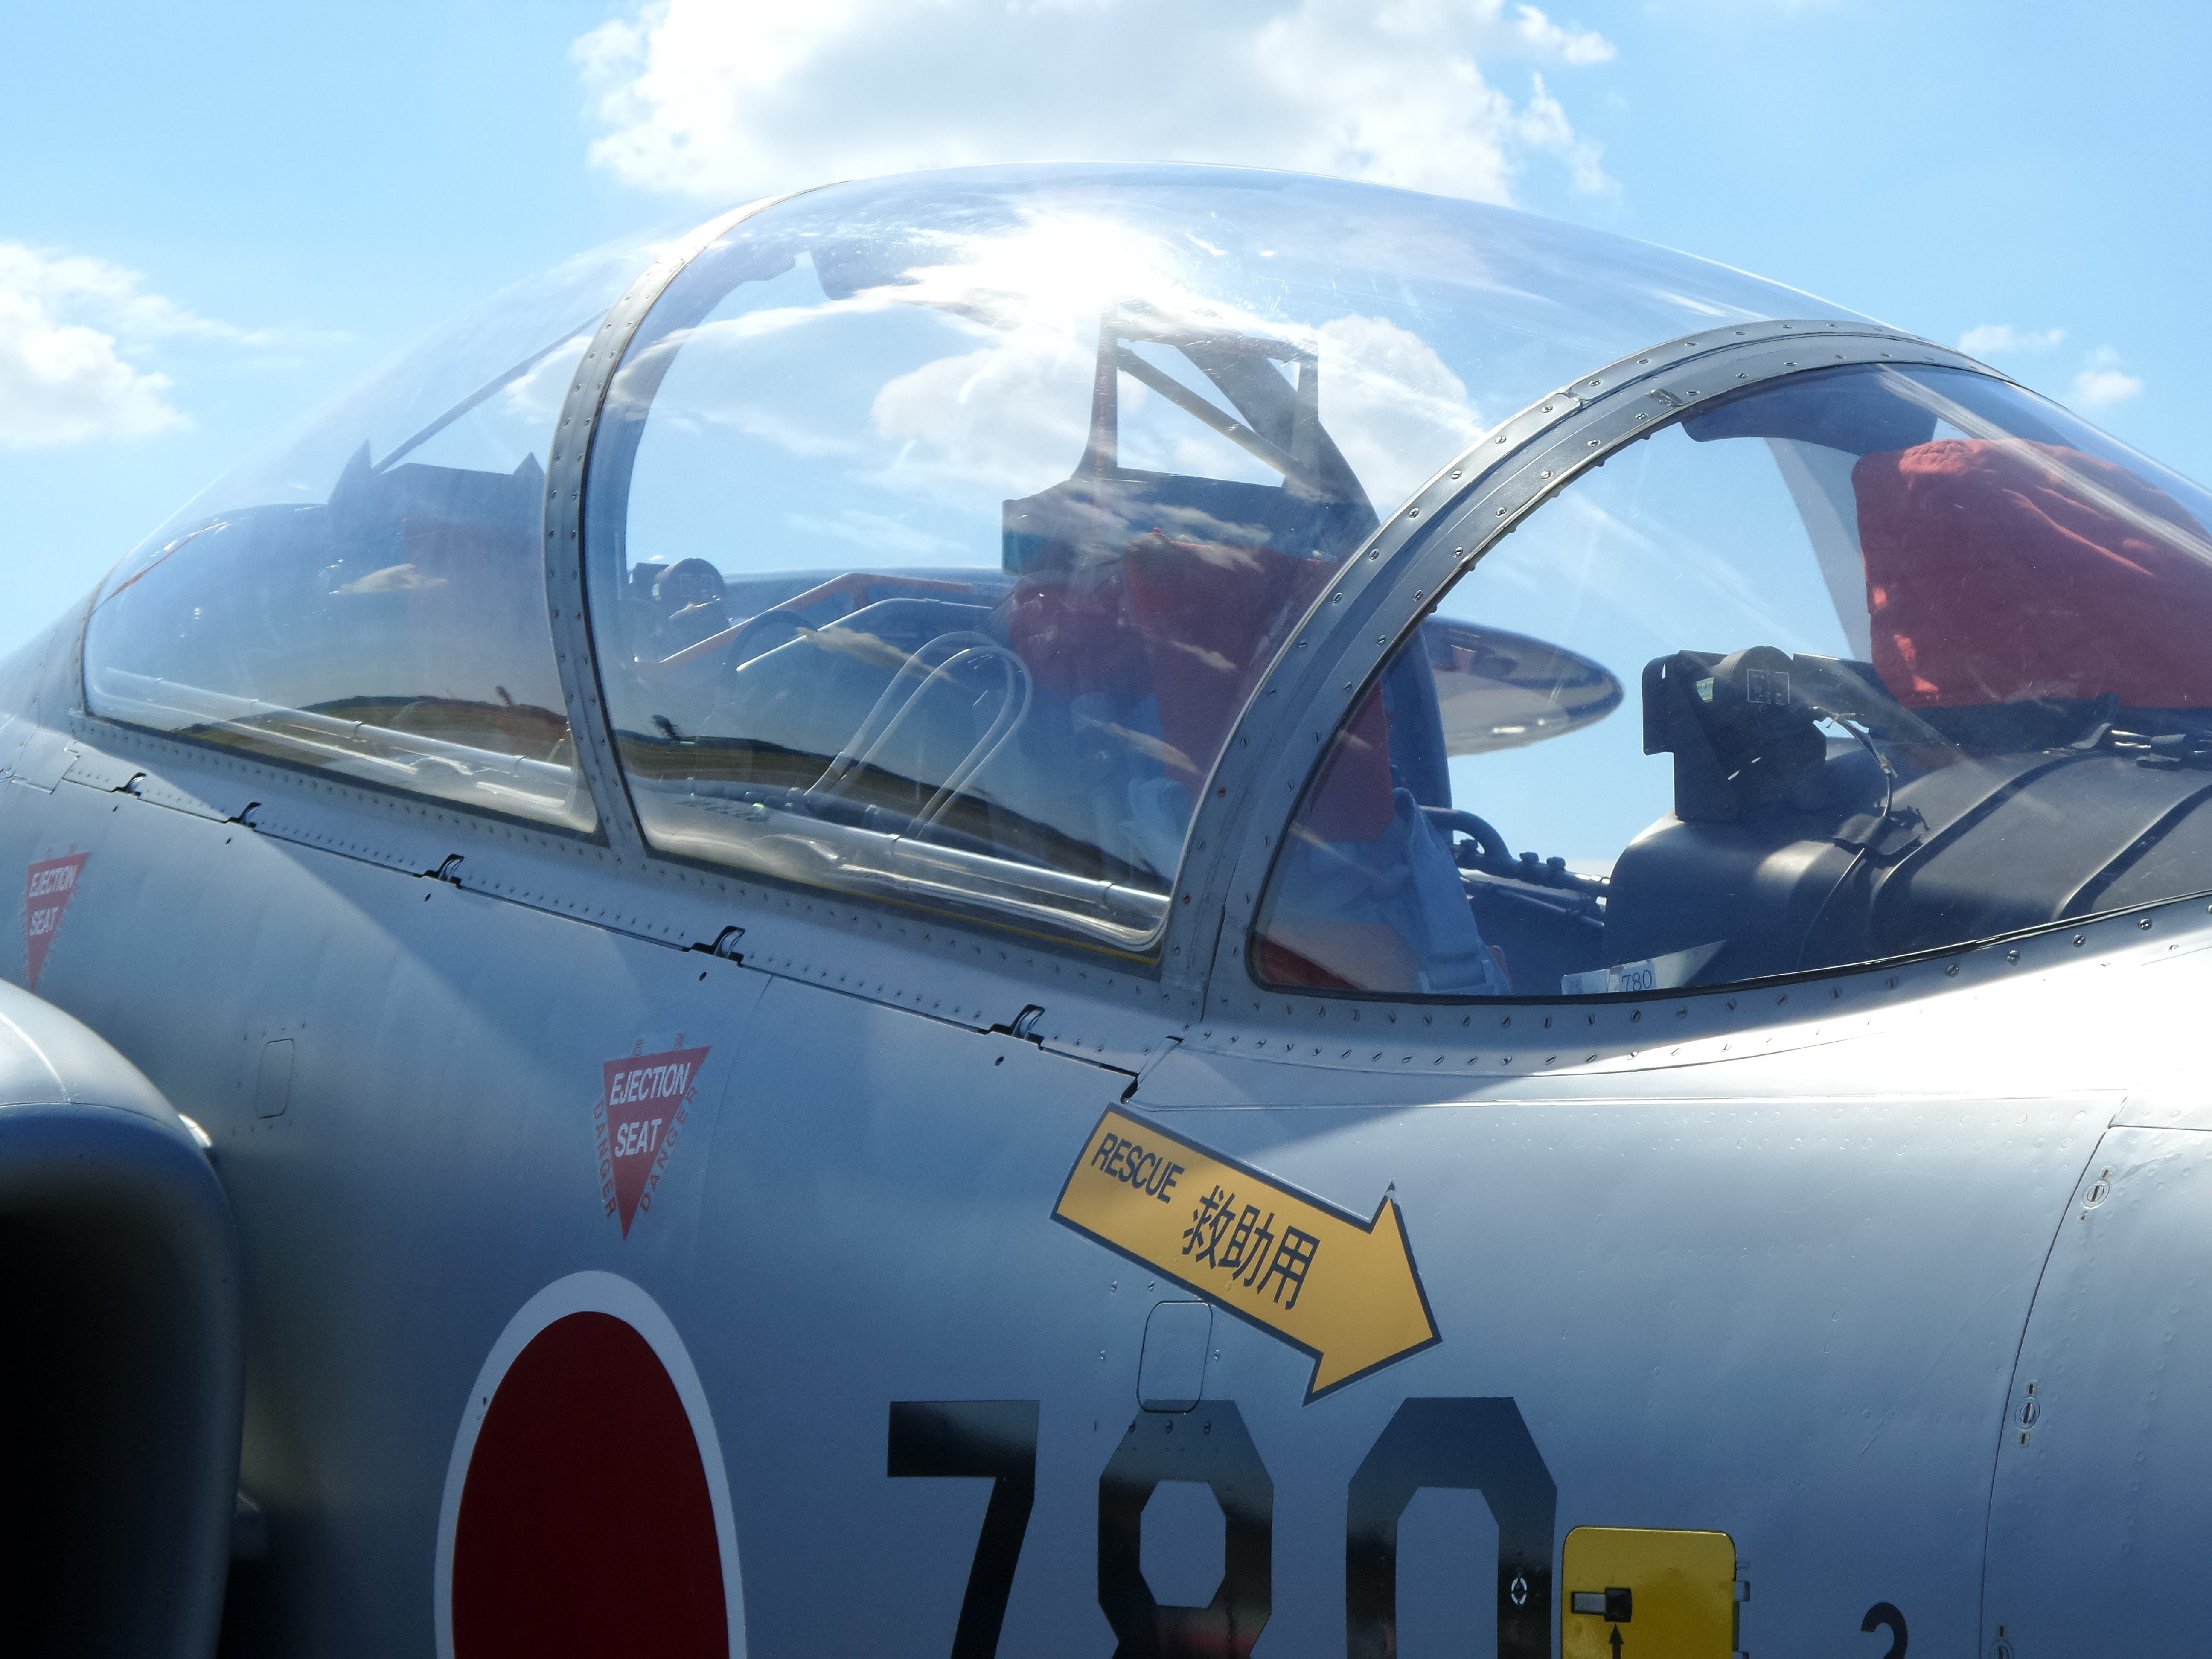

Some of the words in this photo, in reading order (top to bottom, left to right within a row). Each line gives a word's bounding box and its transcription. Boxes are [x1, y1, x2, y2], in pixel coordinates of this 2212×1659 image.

[29, 864, 79, 897] EJECTION
[29, 906, 59, 936] SEAT
[1621, 970, 1652, 991] 780
[609, 1062, 691, 1106] EJECTION
[614, 1118, 662, 1158] SEAT
[1091, 1132, 1185, 1204] RESCUE
[1182, 1185, 1320, 1310] 救助用
